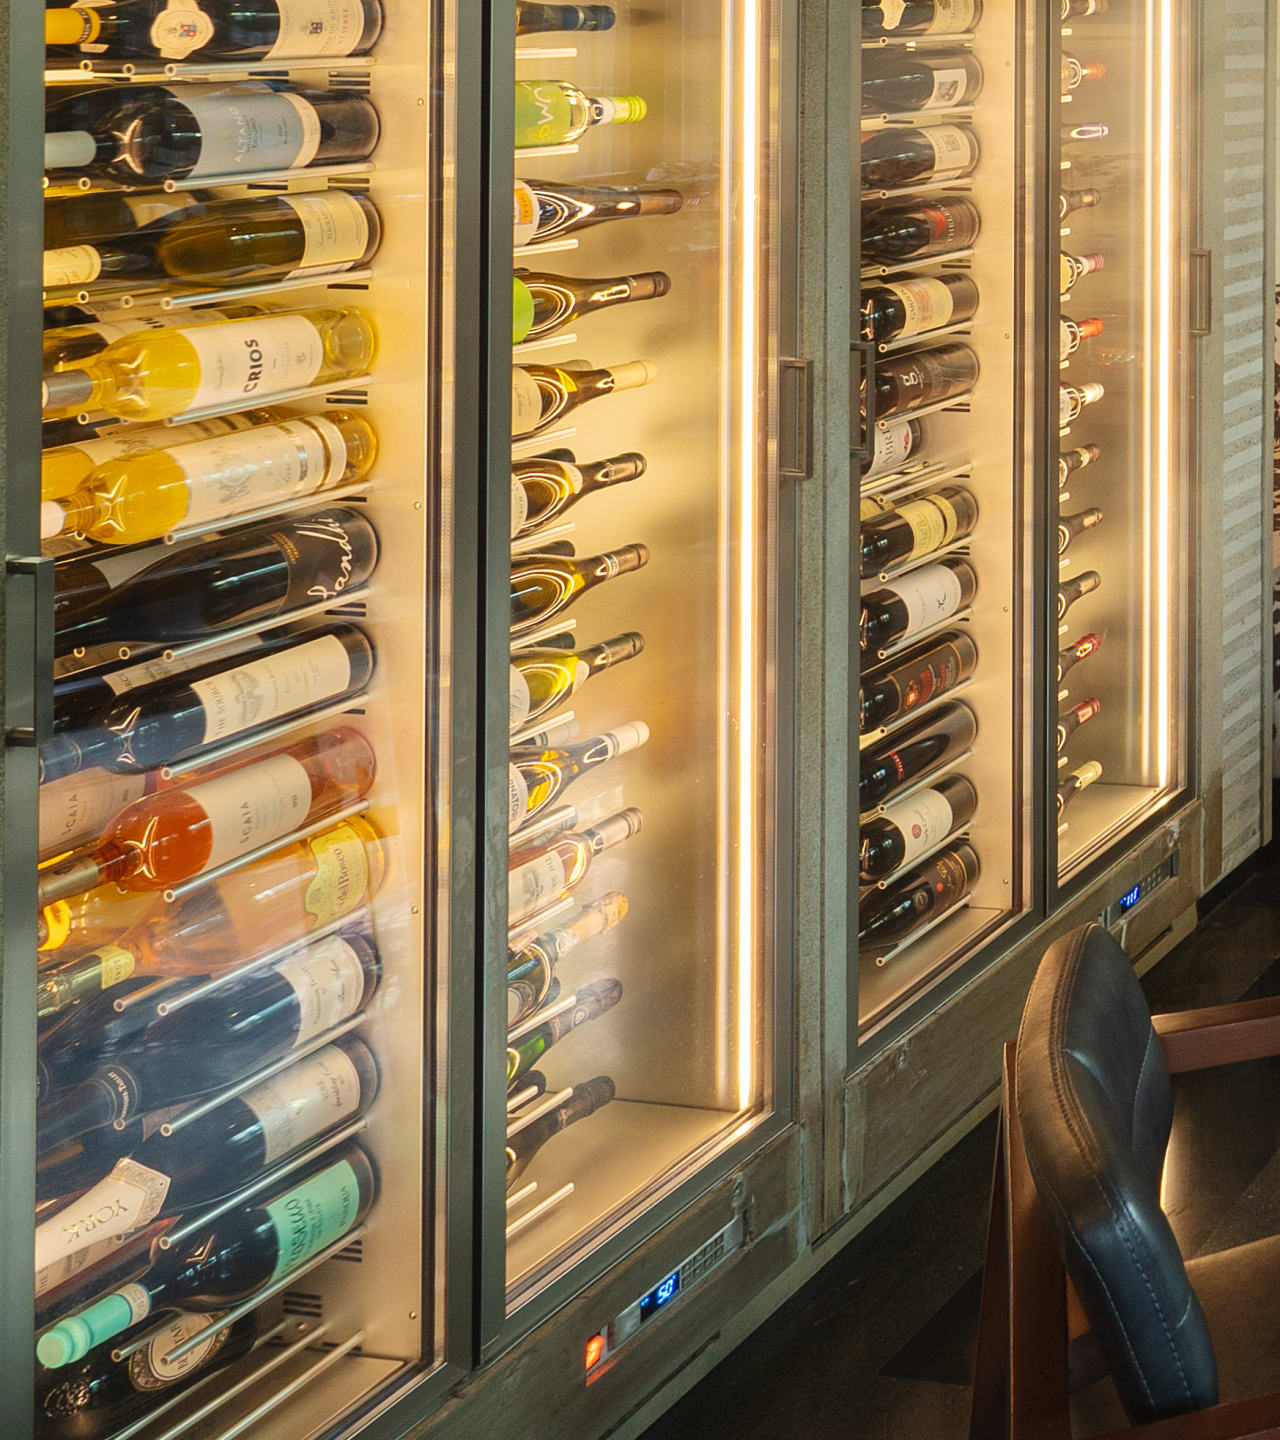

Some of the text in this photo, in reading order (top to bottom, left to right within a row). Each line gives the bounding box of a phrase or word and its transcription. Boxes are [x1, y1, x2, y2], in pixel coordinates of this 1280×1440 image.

[227, 106, 248, 162] ALTANO
[242, 338, 263, 393] CRIOS
[205, 681, 226, 716] SOURCE
[61, 793, 79, 837] SCAIA
[239, 800, 253, 846] SCAIA
[62, 1198, 129, 1244] YORK
